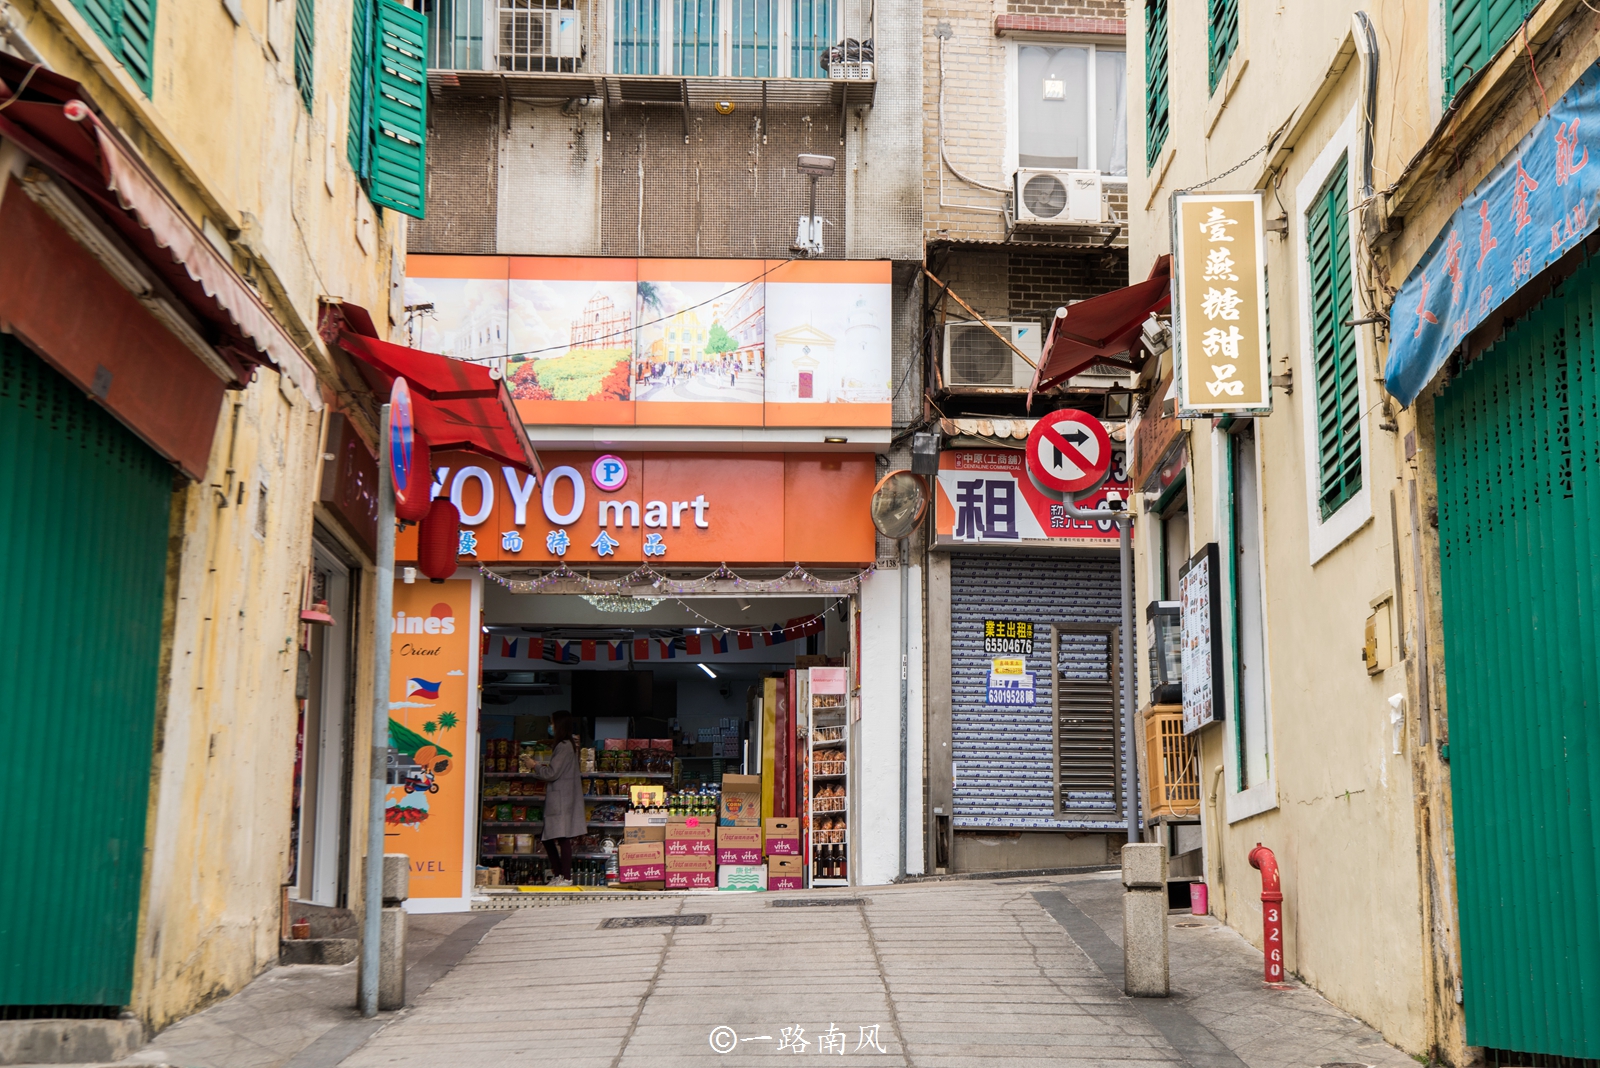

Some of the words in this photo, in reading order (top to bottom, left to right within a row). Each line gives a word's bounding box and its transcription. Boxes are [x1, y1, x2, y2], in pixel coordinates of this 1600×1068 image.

[1511, 247, 1532, 287] NG
[1550, 198, 1587, 253] KAM
[1199, 206, 1245, 398] 壹燕糖甜品
[598, 494, 710, 528] mart
[955, 479, 1019, 540] 租
[885, 559, 897, 568] 138
[985, 620, 1027, 639] 業主出租
[400, 643, 441, 657] Orient
[985, 637, 1032, 654] 65504676
[988, 689, 1025, 704] 63019528
[669, 841, 688, 851] vita
[692, 841, 711, 851] vita
[774, 841, 791, 850] vita
[721, 851, 738, 860] vita
[741, 851, 758, 860] vita
[623, 868, 640, 877] vita
[643, 866, 661, 876] vita
[669, 873, 688, 883] vita
[692, 873, 711, 884] vita
[777, 879, 794, 888] vita
[1267, 908, 1281, 976] 3260
